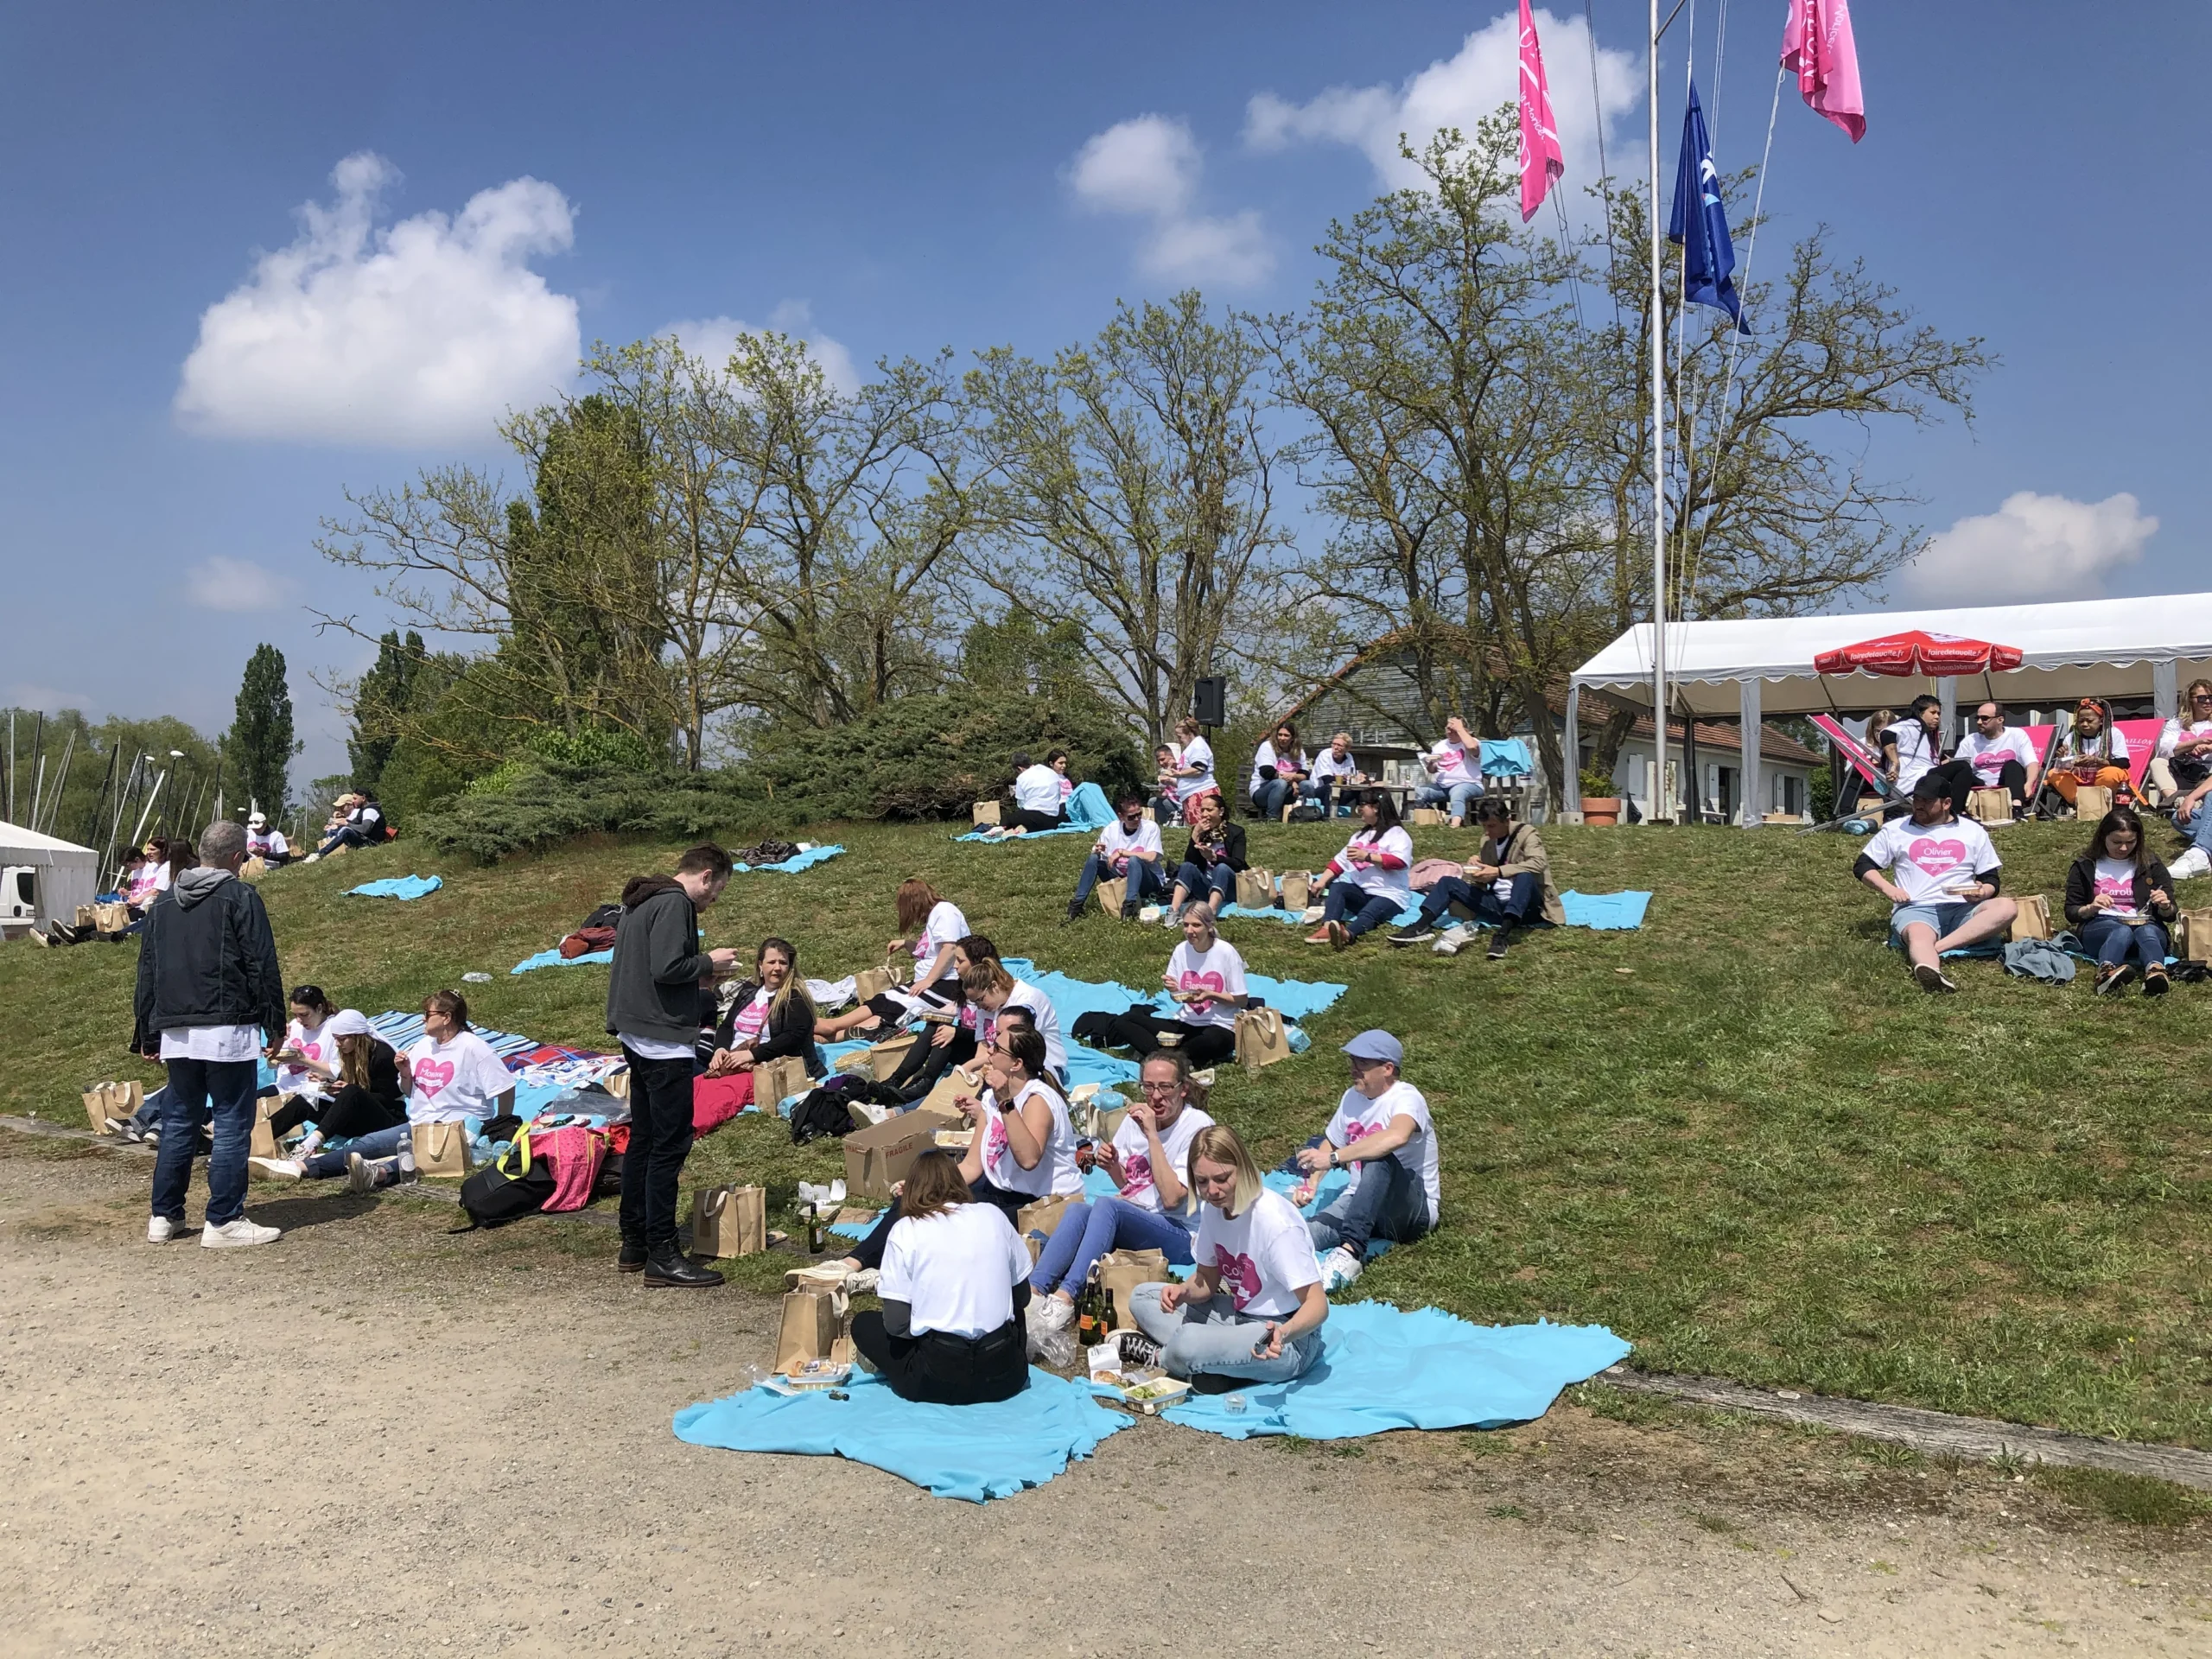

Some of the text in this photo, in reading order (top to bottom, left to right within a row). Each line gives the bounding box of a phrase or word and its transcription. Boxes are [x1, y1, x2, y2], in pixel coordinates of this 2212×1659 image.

[1850, 649, 1904, 661] fairedelavoile.fr
[1927, 648, 1983, 657] fairedelavoile.fr
[1923, 847, 1953, 856] Olivier
[886, 1142, 913, 1159] FRAGILE
